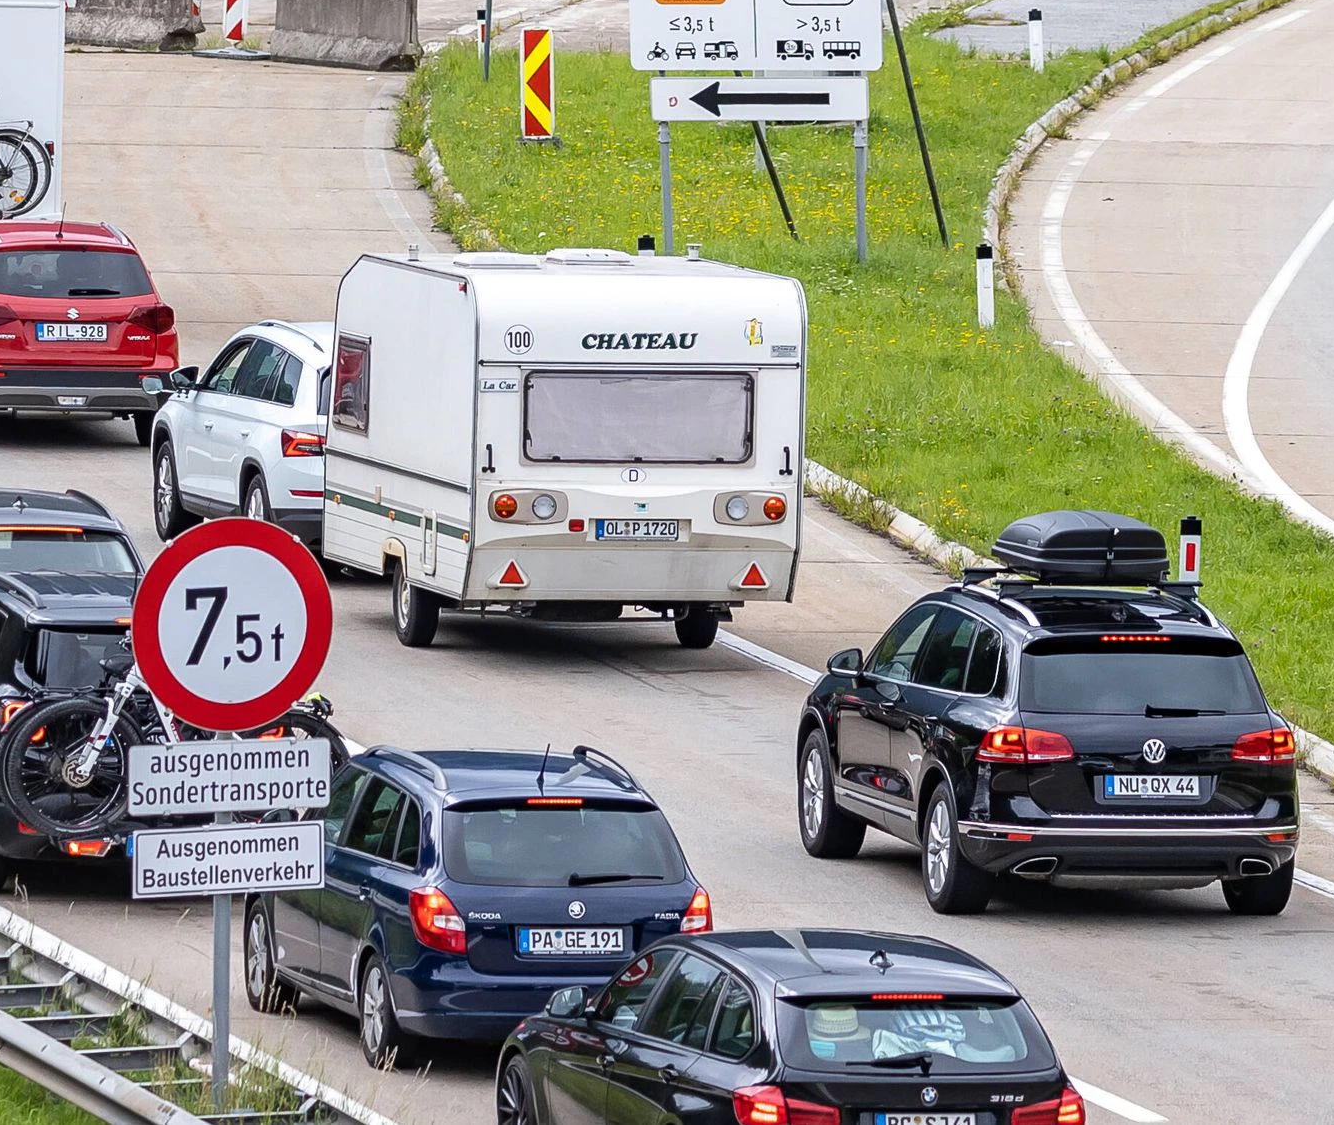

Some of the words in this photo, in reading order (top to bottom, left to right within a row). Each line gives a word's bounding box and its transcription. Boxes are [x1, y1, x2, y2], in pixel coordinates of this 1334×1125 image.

[46, 324, 104, 338] RIL-928
[508, 331, 530, 348] 100
[581, 332, 698, 350] CHATEAU
[483, 381, 496, 391] La
[499, 381, 517, 391] Car
[629, 469, 639, 482] D
[606, 521, 623, 536] OL
[632, 521, 642, 536] P
[643, 521, 676, 537] 1720
[185, 586, 262, 671] 7,5
[270, 623, 285, 662] t
[150, 748, 310, 778] ausgenommen
[132, 776, 327, 806] Sondertransporte
[1119, 778, 1139, 793] NU
[1151, 778, 1171, 793] QX
[1176, 778, 1195, 793] 44
[156, 835, 299, 862] Ausgenommen
[142, 862, 314, 889] Baustellenverkehr
[468, 911, 501, 920] ŠKODA
[655, 912, 680, 920] FABIA
[531, 931, 554, 949] PA
[565, 931, 587, 948] GE
[591, 931, 621, 948] 191
